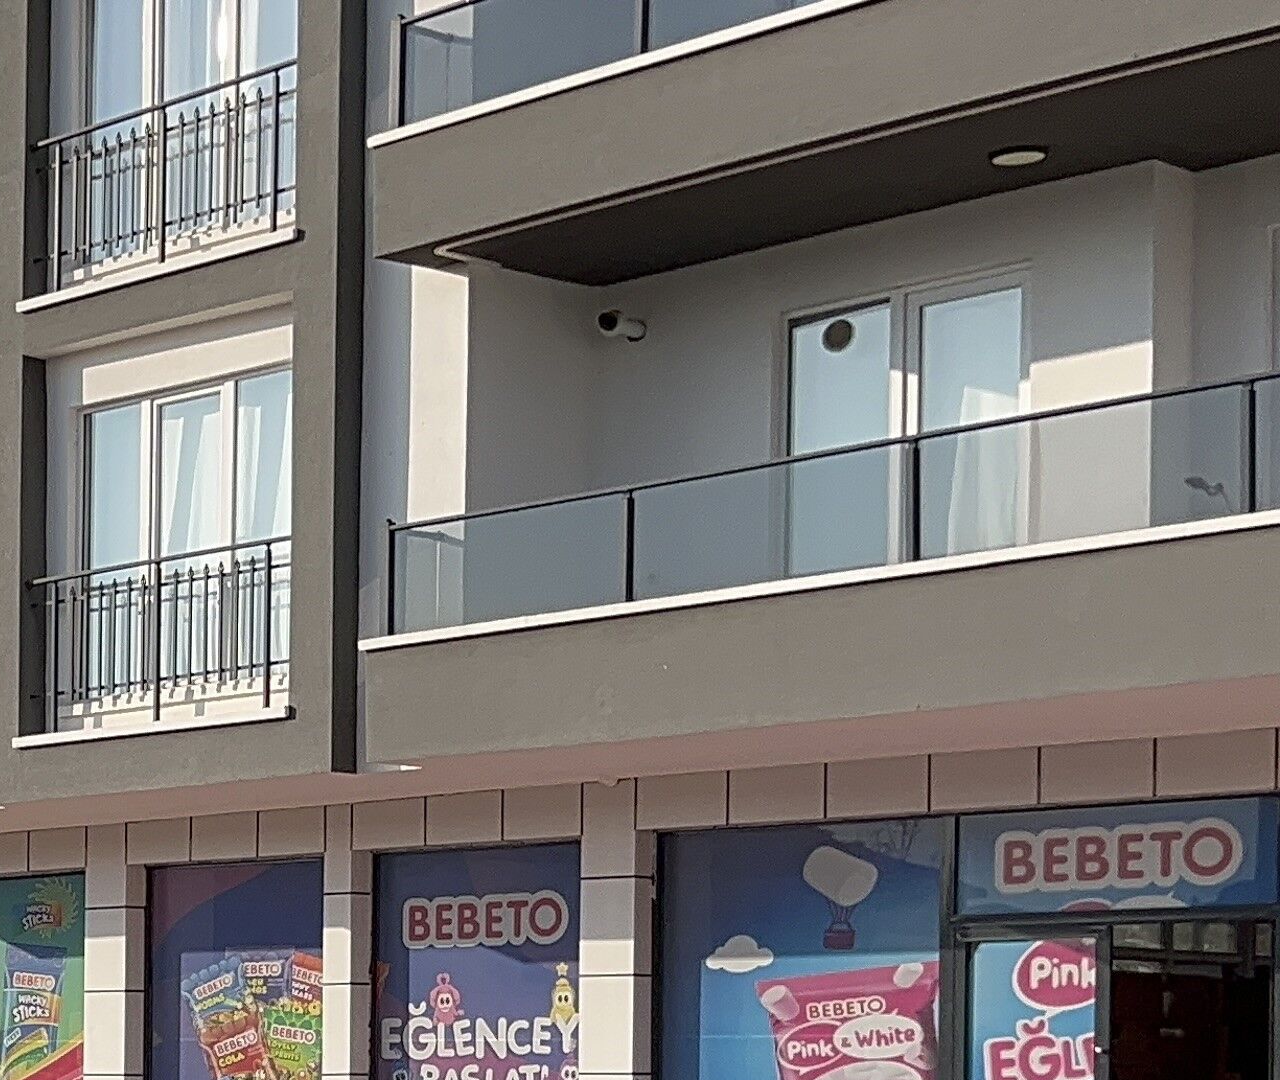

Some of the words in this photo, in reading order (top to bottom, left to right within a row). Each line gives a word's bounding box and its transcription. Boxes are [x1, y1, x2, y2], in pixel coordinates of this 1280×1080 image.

[1002, 827, 1233, 886] BEBETO
[408, 897, 563, 942] BEBETO
[244, 964, 280, 974] EBETO
[15, 974, 54, 987] BEBETO
[196, 975, 231, 998] BEBETO
[809, 998, 884, 1019] BEBETO
[216, 1033, 257, 1054] BEBETO
[272, 1026, 314, 1042] BEBETO
[787, 1038, 836, 1061] Pink
[841, 1036, 852, 1048] &
[854, 1026, 916, 1048] White
[219, 1052, 245, 1067] COLA
